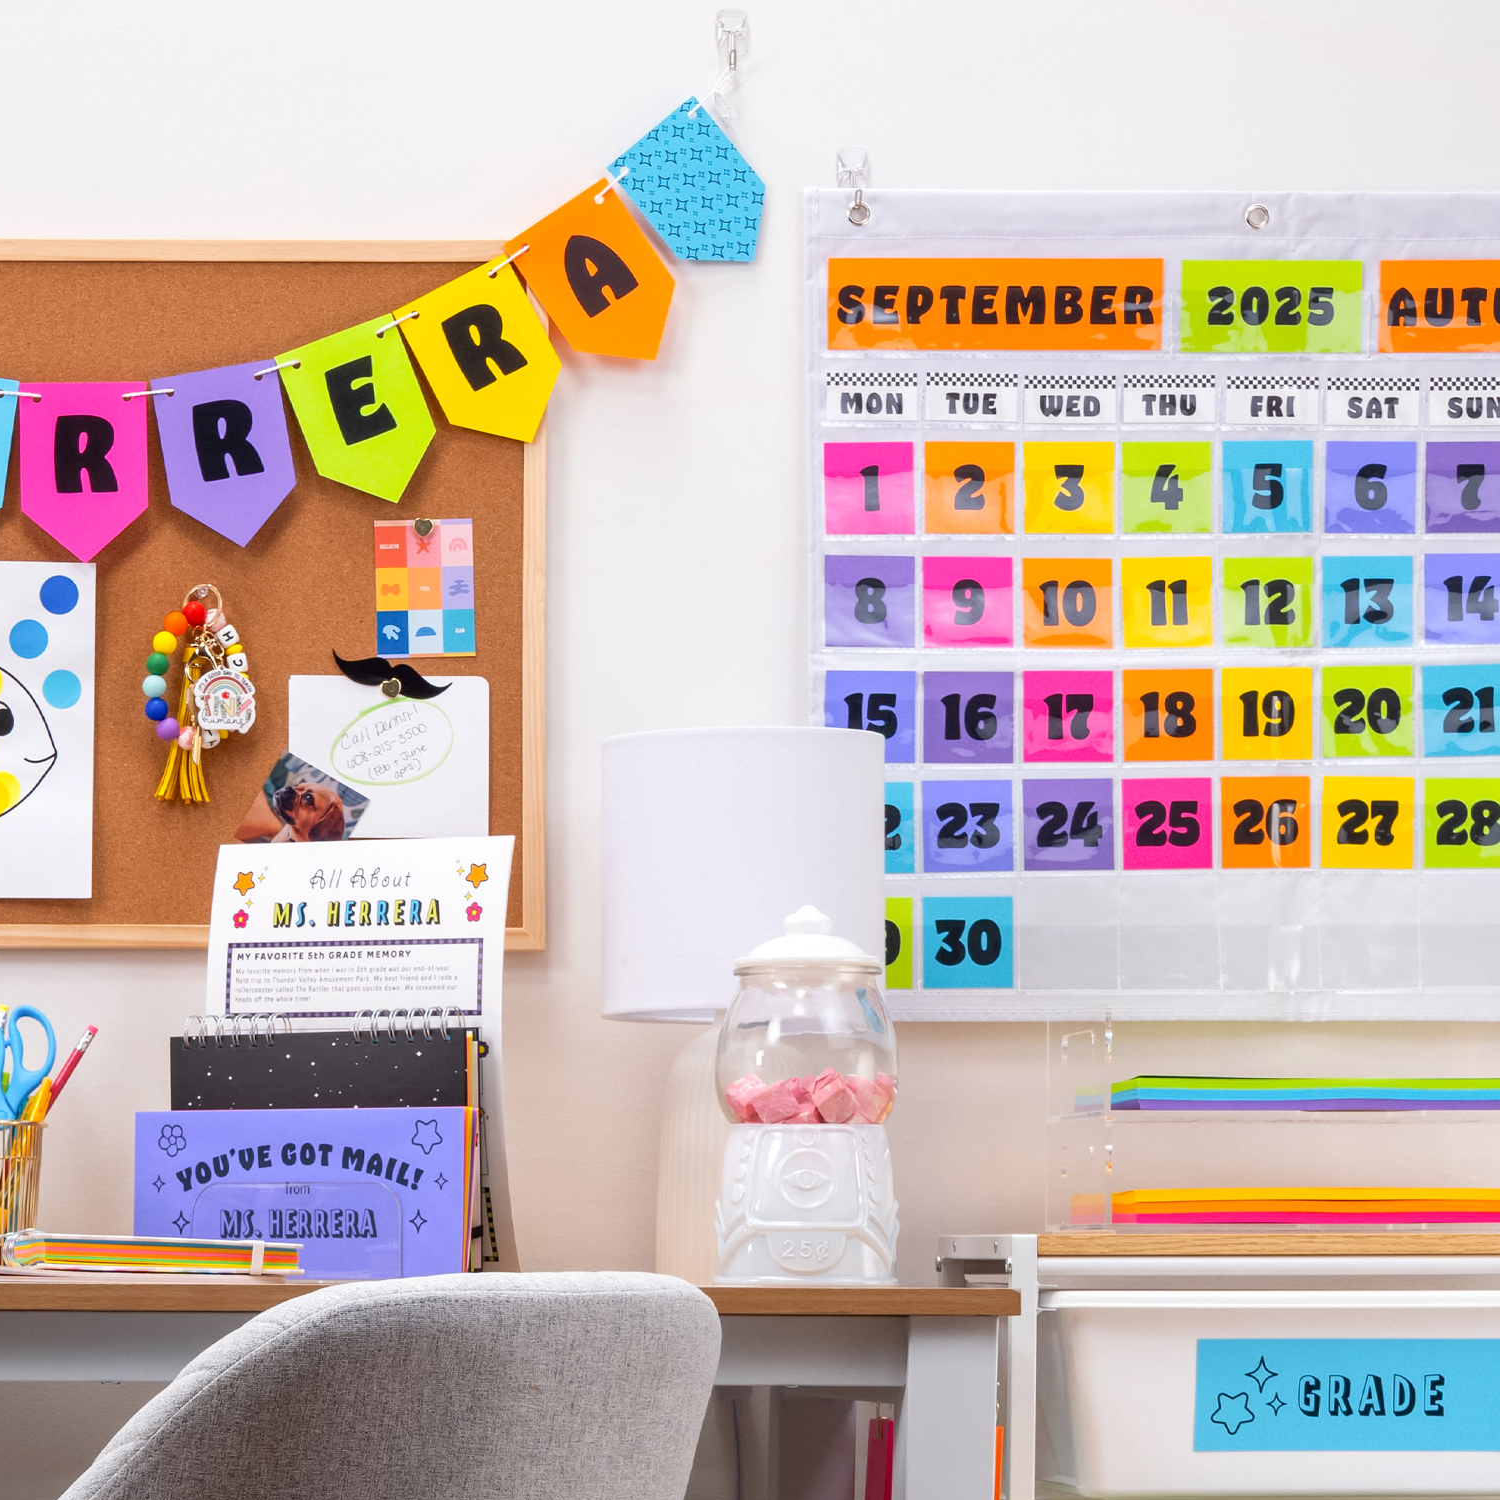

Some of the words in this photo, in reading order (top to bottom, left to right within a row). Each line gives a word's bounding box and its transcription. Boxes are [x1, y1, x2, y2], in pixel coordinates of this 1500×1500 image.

[836, 285, 1155, 326] SEPTEMBER
[1206, 286, 1336, 327] 2025
[1386, 286, 1500, 327] AUT
[840, 392, 903, 415] MON
[945, 392, 997, 415] TUE
[1039, 395, 1101, 418] WED
[1142, 393, 1197, 417] THU
[1250, 395, 1295, 418] FRI
[1347, 396, 1399, 419] SAT
[1447, 396, 1500, 419] SUN
[860, 464, 880, 512] 1
[953, 464, 985, 511] 2
[1053, 464, 1085, 511] 3
[1150, 463, 1184, 511] 4
[1251, 463, 1284, 510] 5
[1355, 463, 1388, 511] 6
[1456, 463, 1486, 511] 7
[854, 577, 887, 624] 8
[952, 579, 986, 625] 9
[1039, 580, 1097, 627] 10
[1146, 579, 1188, 627] 11
[1243, 578, 1296, 626] 12
[1341, 577, 1395, 625] 13
[1443, 575, 1499, 622] 14
[843, 692, 898, 739] 15
[940, 693, 998, 741] 16
[1043, 693, 1094, 740] 17
[1139, 691, 1197, 738] 18
[1240, 690, 1295, 737] 19
[1333, 687, 1402, 735] 20
[1441, 686, 1495, 734] 21
[341, 725, 371, 750] Call
[400, 745, 428, 762] June
[935, 802, 1001, 849] 23
[1035, 801, 1104, 848] 24
[1134, 800, 1200, 847] 25
[1233, 799, 1299, 846] 26
[1336, 799, 1400, 846] 27
[1435, 799, 1500, 847] 28
[310, 868, 343, 890] All
[350, 867, 412, 889] About
[273, 901, 316, 928] MS.
[327, 898, 441, 927] HERRERA
[237, 953, 251, 961] MY
[254, 952, 304, 961] FAVORITE
[308, 951, 325, 960] 5th
[328, 951, 363, 960] GRADE
[366, 950, 411, 959] MEMORY
[934, 918, 1002, 967] 30
[236, 968, 245, 976] My
[272, 968, 296, 976] memory
[369, 966, 387, 974] grade
[413, 965, 450, 973] end-of-year
[319, 976, 354, 984] Amusement
[373, 975, 383, 983] My
[281, 1142, 333, 1167] GOT
[342, 1145, 424, 1191] MAIL!
[285, 1181, 311, 1196] from
[219, 1208, 263, 1239] MS.
[268, 1208, 378, 1239] HERRERA
[781, 1239, 831, 1262] 25¢
[1296, 1372, 1446, 1418] GRADE
